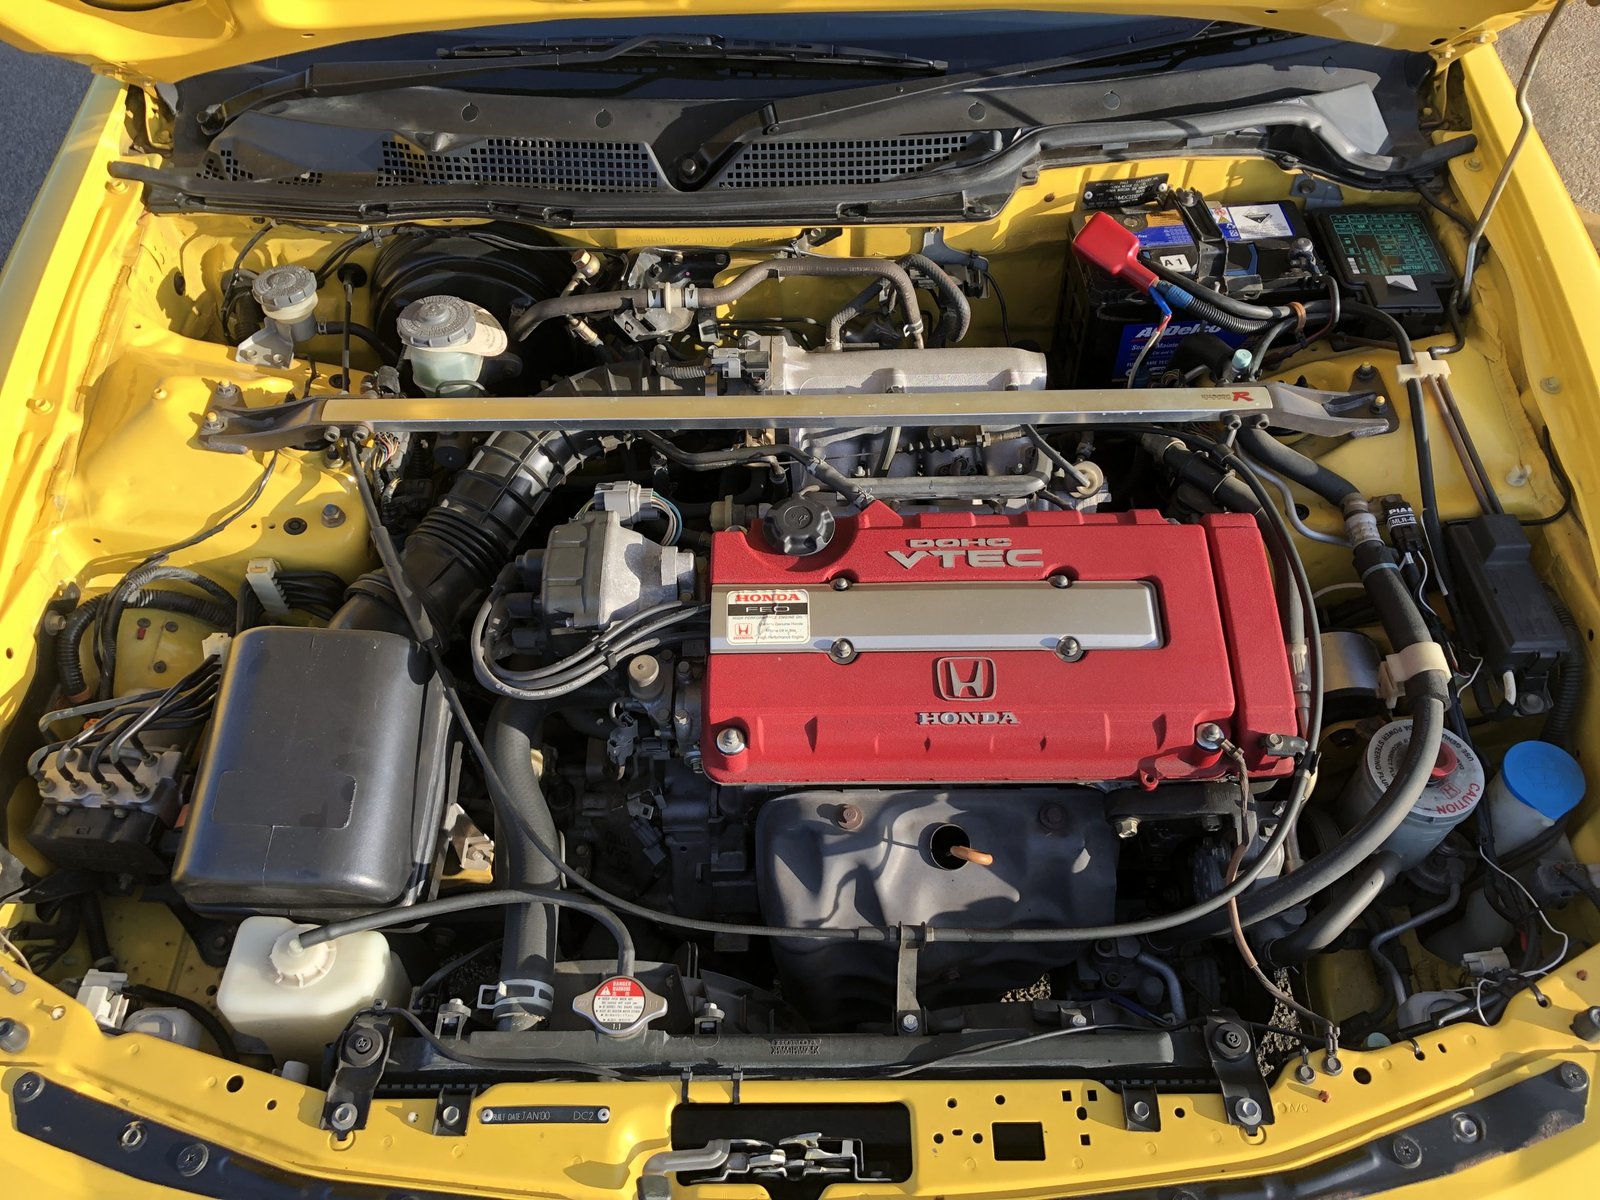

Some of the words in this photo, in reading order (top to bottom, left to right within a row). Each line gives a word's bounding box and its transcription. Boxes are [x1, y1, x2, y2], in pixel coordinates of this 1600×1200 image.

[1176, 258, 1183, 266] 1
[1232, 391, 1254, 402] R
[909, 537, 1012, 548] DOHC
[887, 549, 1044, 569] VTEC
[736, 593, 801, 602] HONDA
[745, 605, 790, 613] FEO
[919, 712, 1019, 725] HONDA
[1383, 727, 1403, 742] POWER
[1374, 740, 1385, 770] STEERING
[1461, 748, 1474, 762] USE
[1436, 783, 1480, 814] CAUTION
[1289, 1103, 1309, 1113] A/C
[573, 1111, 594, 1121] DC2
